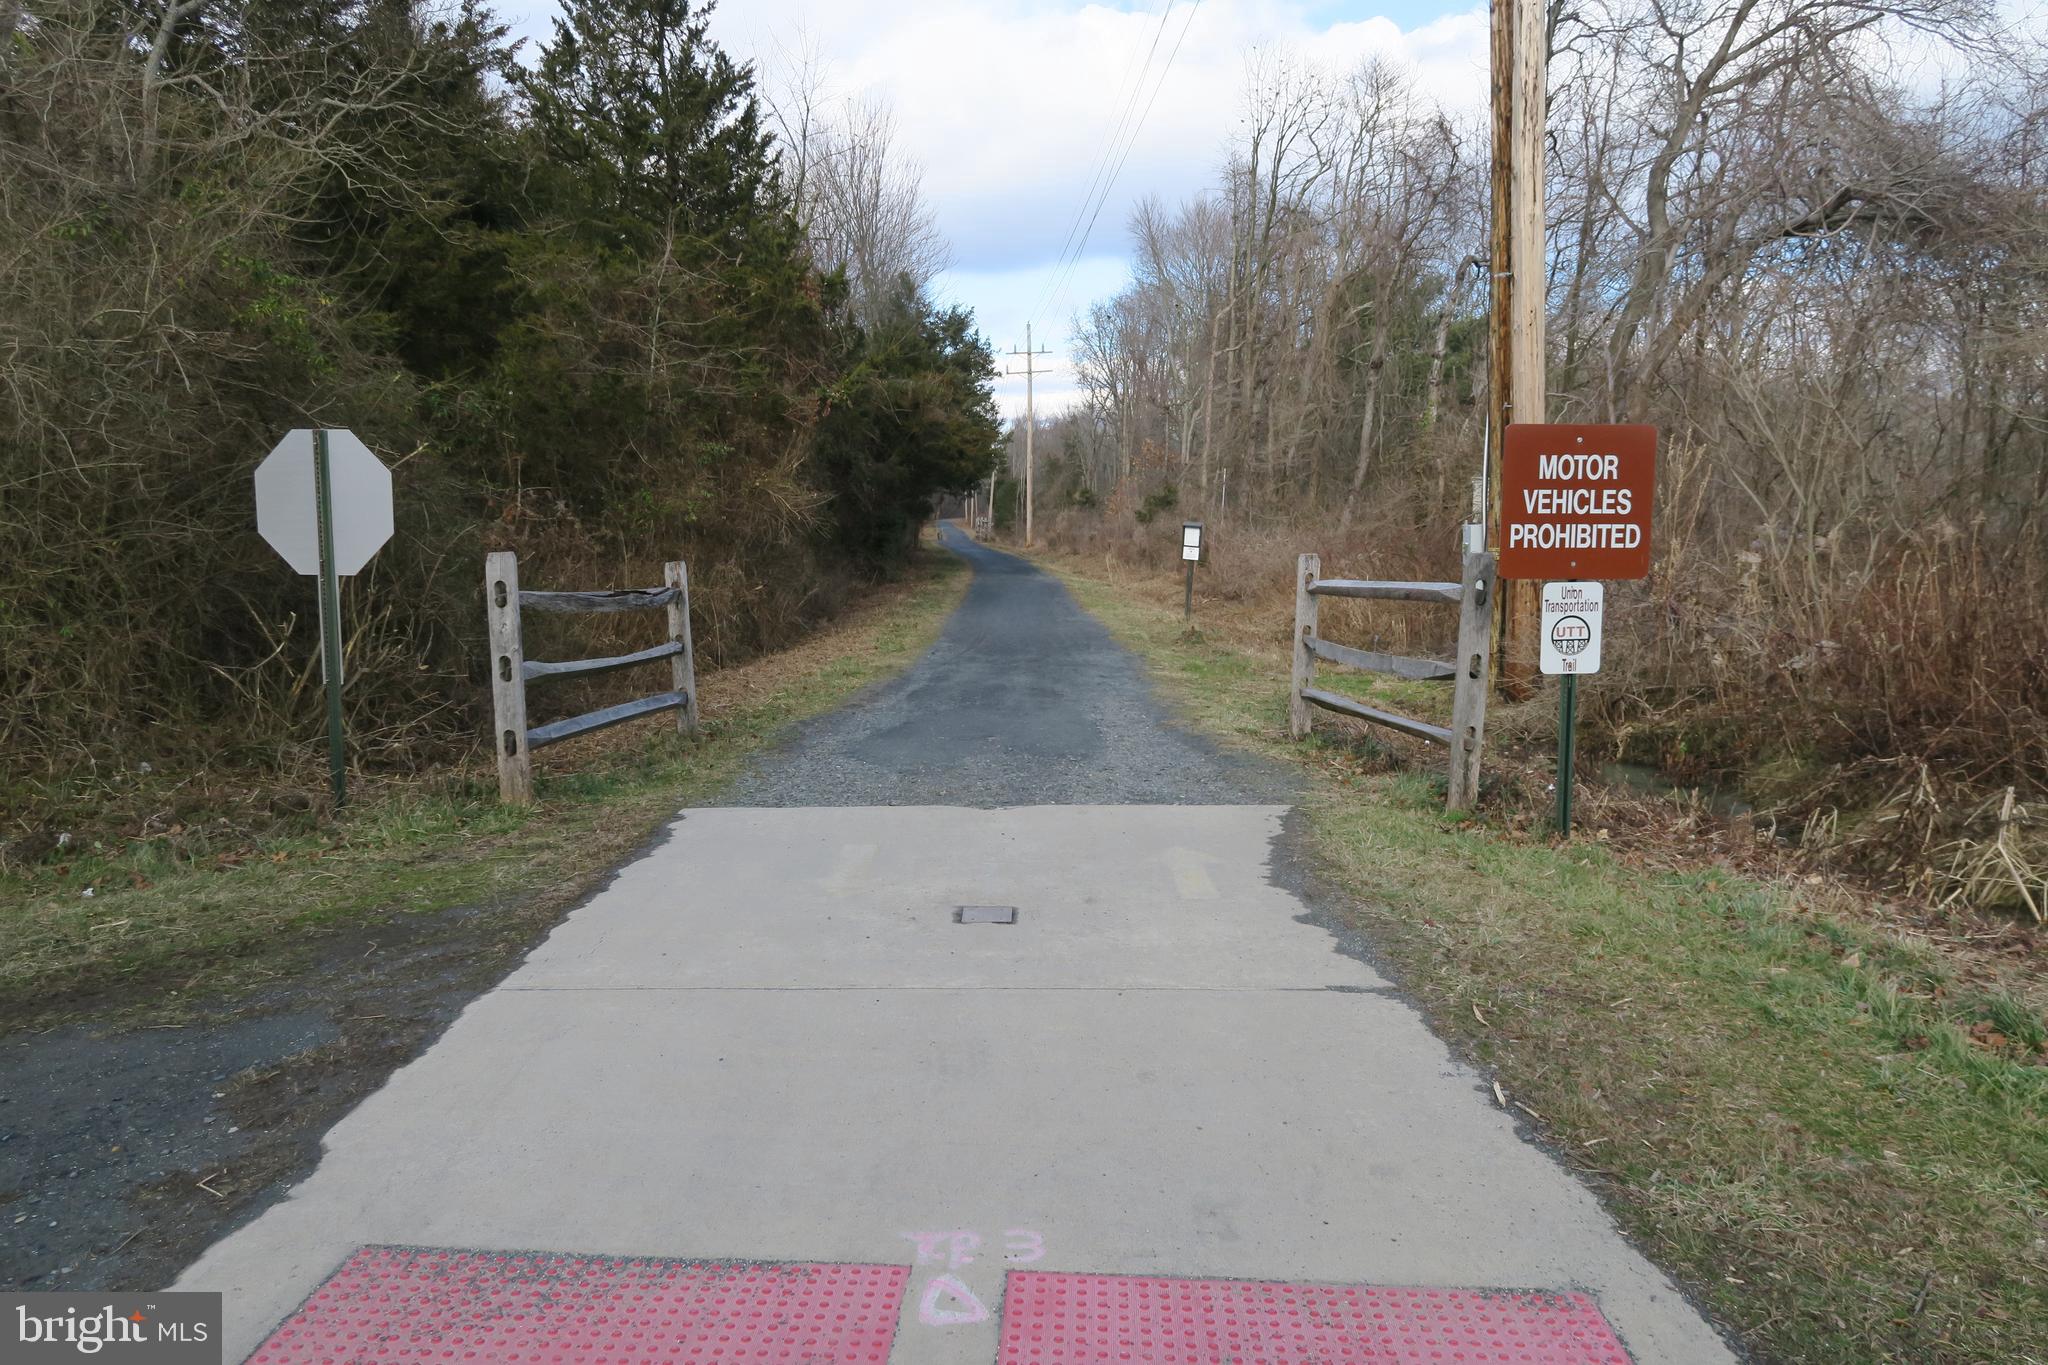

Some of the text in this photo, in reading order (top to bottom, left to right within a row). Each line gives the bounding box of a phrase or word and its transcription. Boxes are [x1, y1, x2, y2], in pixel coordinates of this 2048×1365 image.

[1539, 454, 1619, 480] MOTOR
[1523, 488, 1632, 515] VEHICLES
[1509, 523, 1641, 549] PROHIBITED
[1561, 586, 1583, 600] Union
[1544, 599, 1599, 614] Transportation
[1556, 626, 1586, 638] UTT
[1562, 658, 1577, 672] Trail
